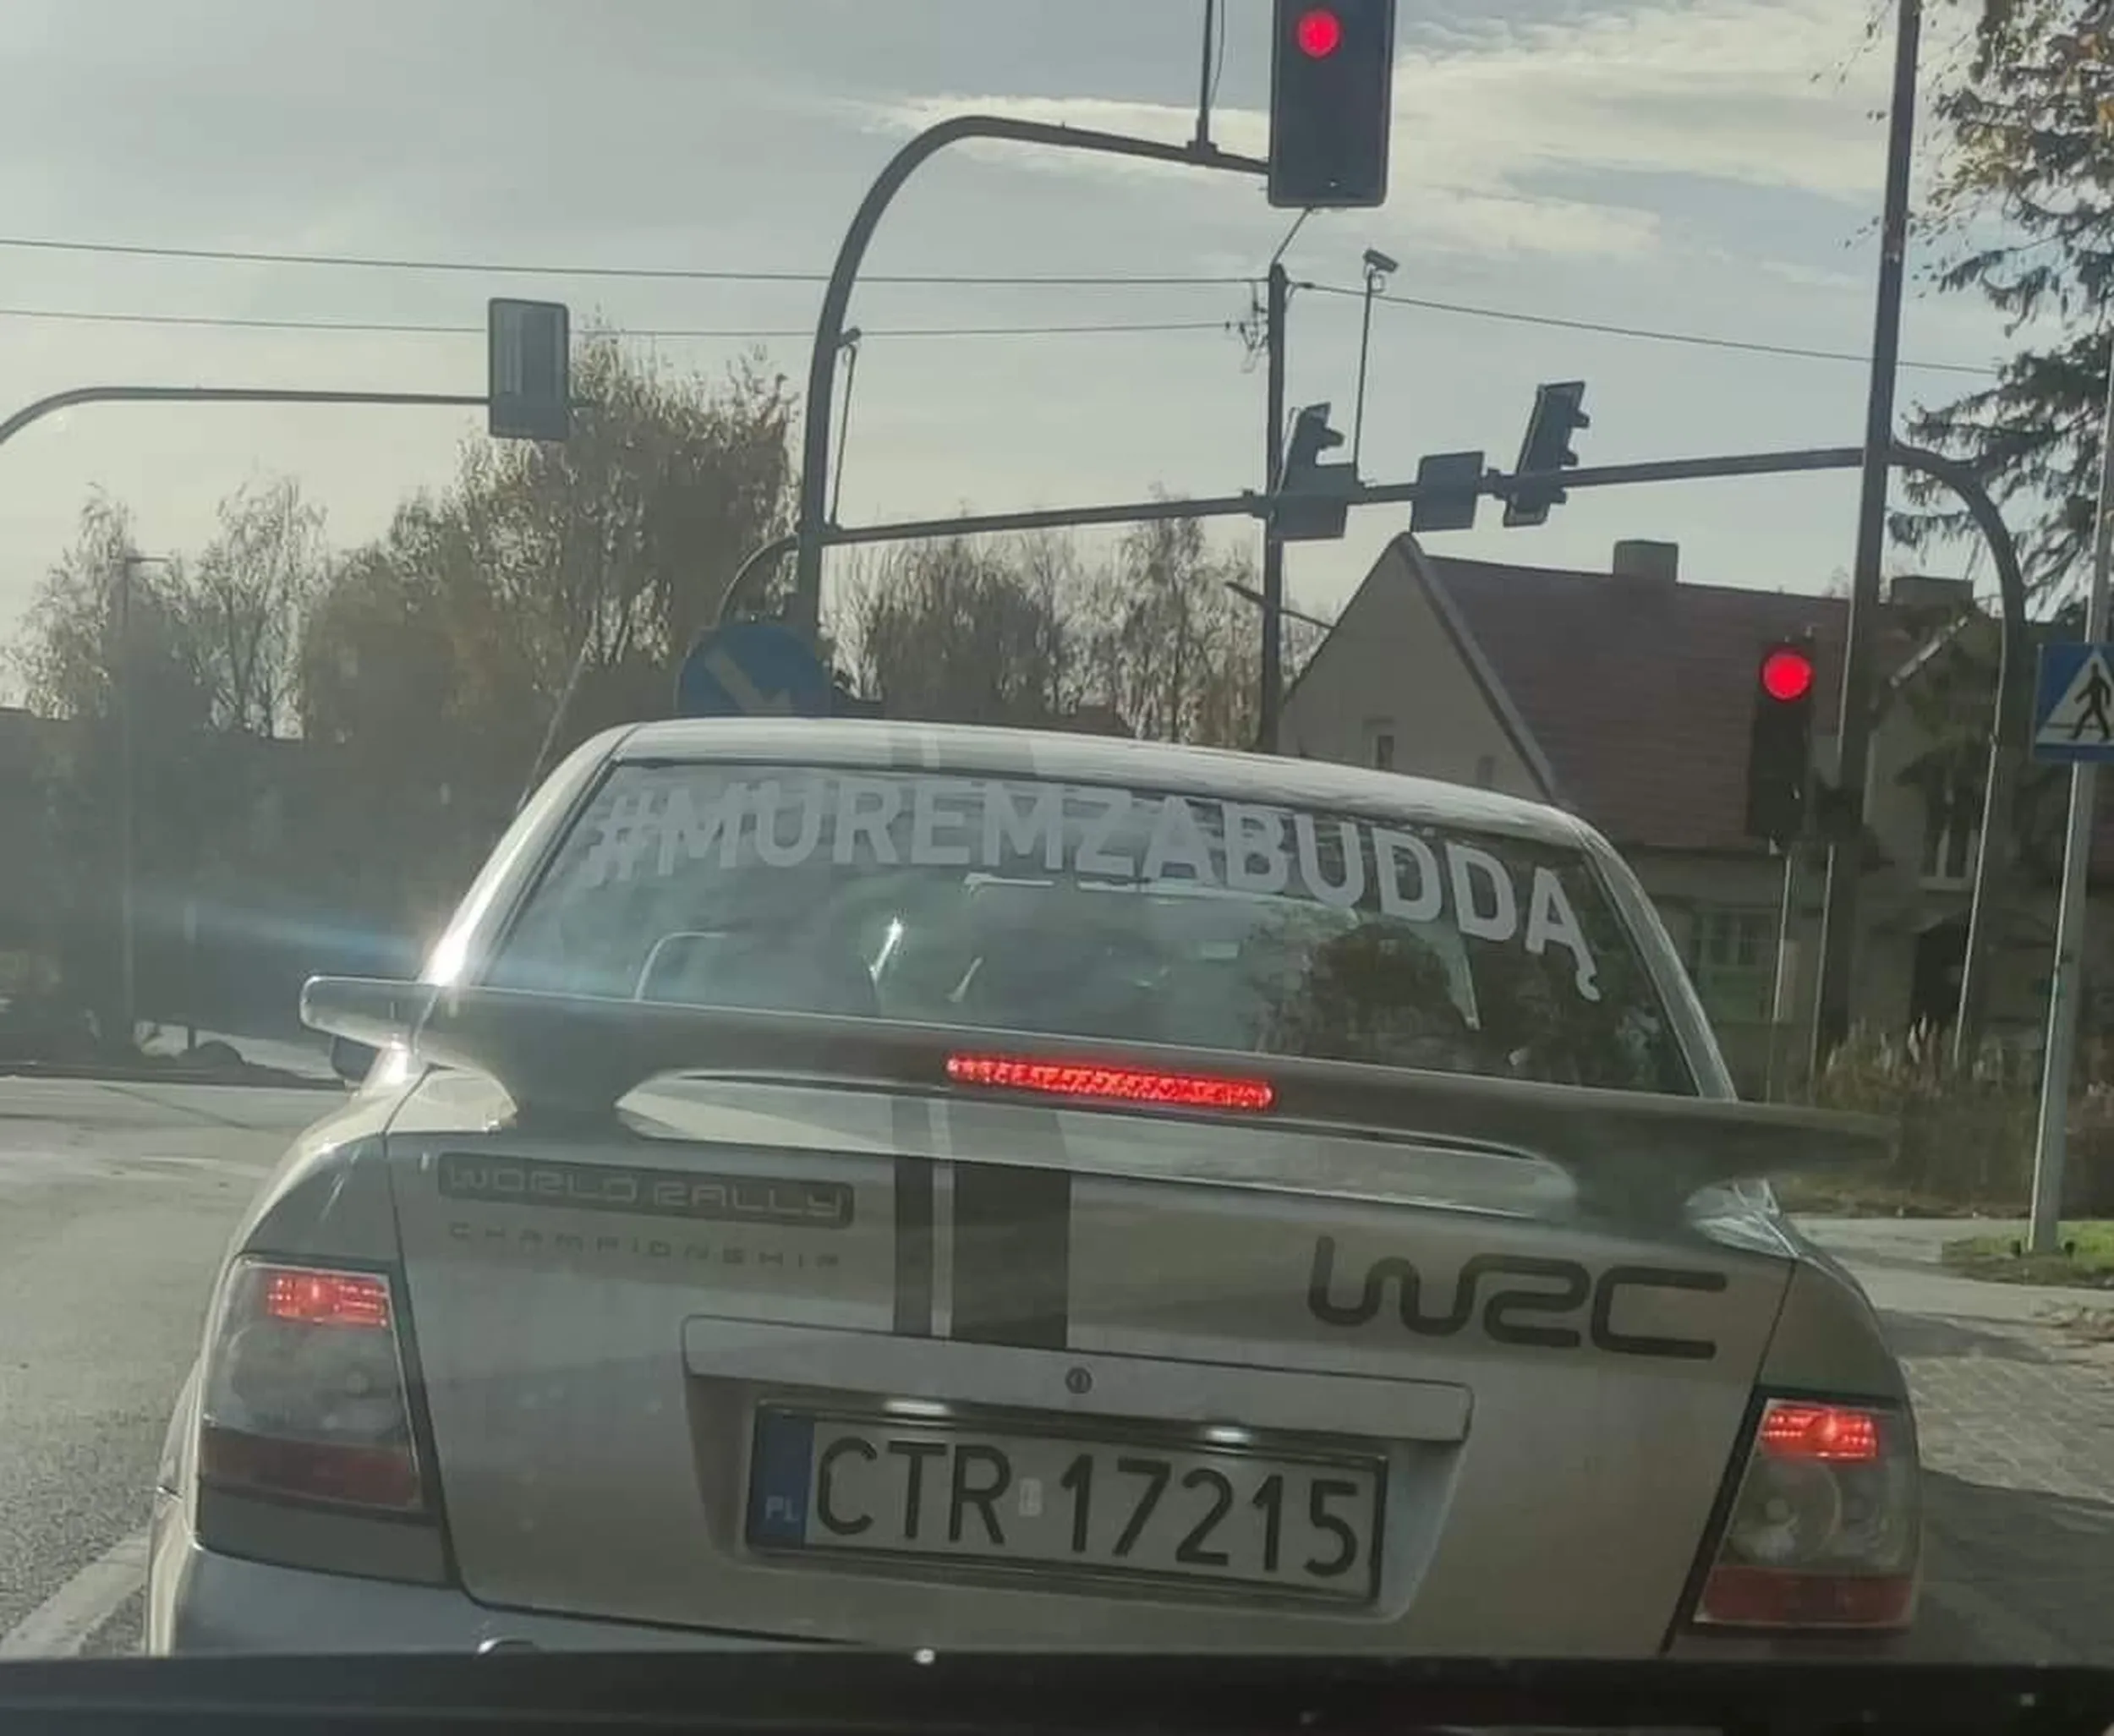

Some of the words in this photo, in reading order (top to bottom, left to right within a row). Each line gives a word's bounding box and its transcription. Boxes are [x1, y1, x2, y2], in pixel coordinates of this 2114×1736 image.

[450, 1163, 638, 1204] WORLD
[653, 1184, 842, 1218] RALLY
[1306, 1235, 1728, 1360] WRC
[764, 1497, 800, 1522] PL
[816, 1436, 1012, 1546] CTR
[1059, 1454, 1360, 1577] 17215
